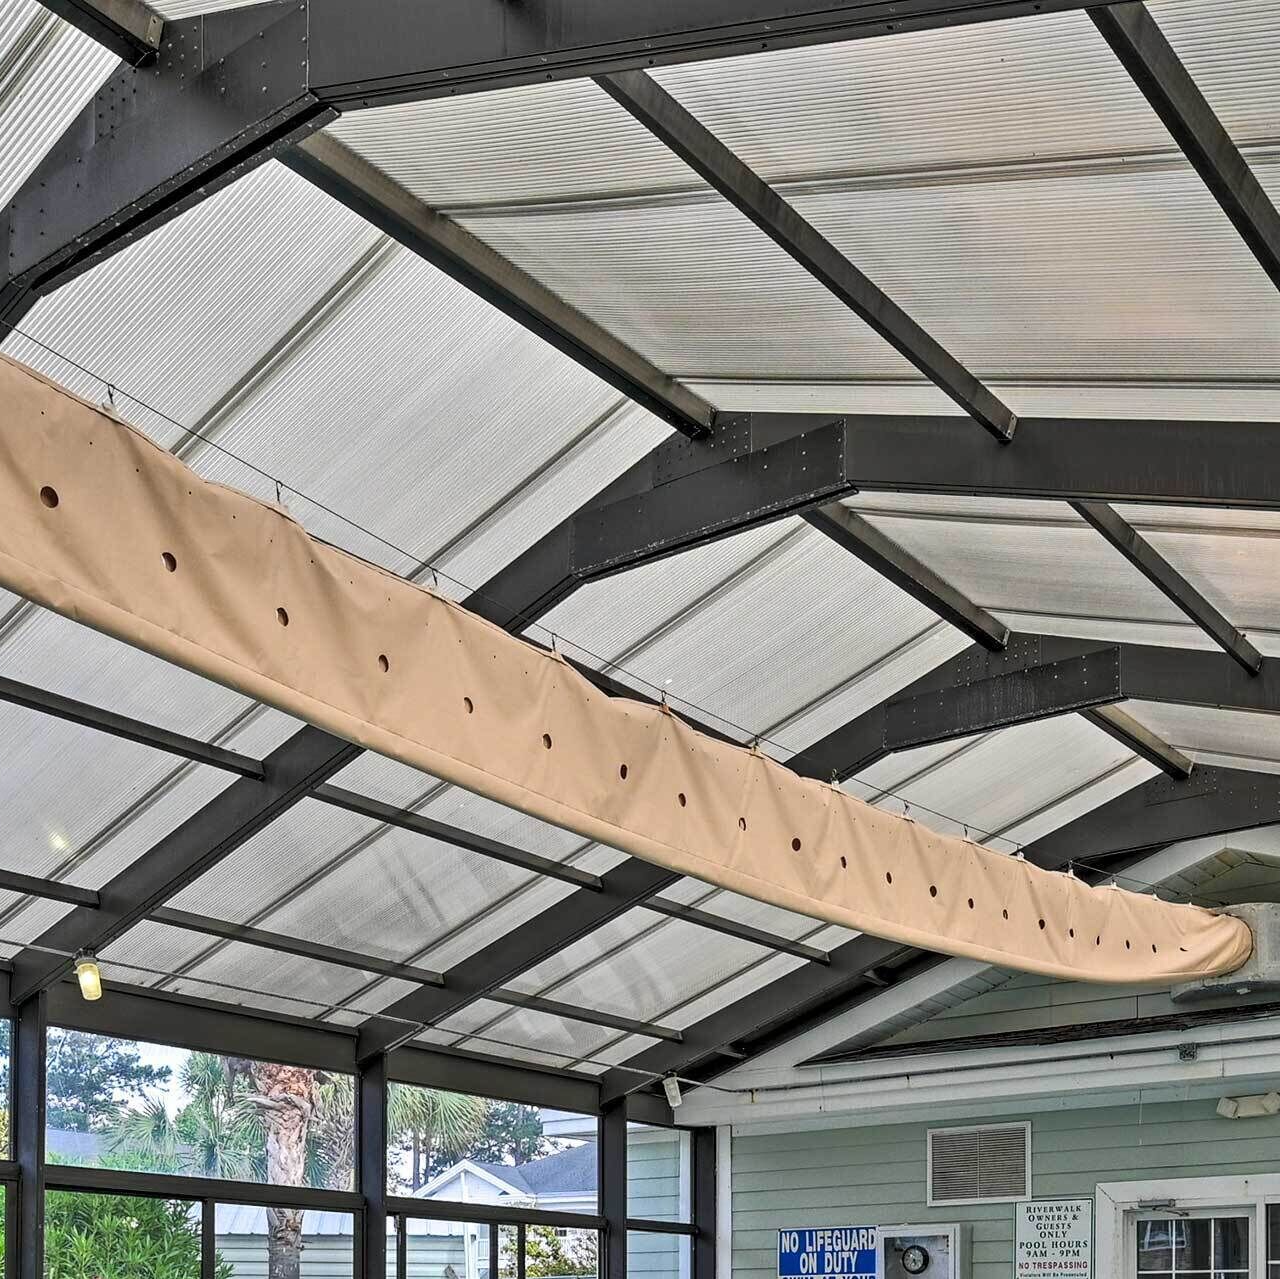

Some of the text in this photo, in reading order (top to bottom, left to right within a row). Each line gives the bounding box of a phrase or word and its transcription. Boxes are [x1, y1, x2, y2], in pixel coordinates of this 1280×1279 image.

[1026, 1205, 1082, 1213] RIVERWALK
[1028, 1214, 1068, 1222] OWNERS
[1036, 1222, 1072, 1230] GUESTS
[1040, 1231, 1067, 1239] ONLY
[781, 1229, 876, 1253] NO LIFEGUARD
[1052, 1240, 1088, 1248] HOURS
[1026, 1250, 1047, 1258] 9AM
[800, 1252, 857, 1274] ON DUTY
[1033, 1261, 1088, 1269] TRESPASSING
